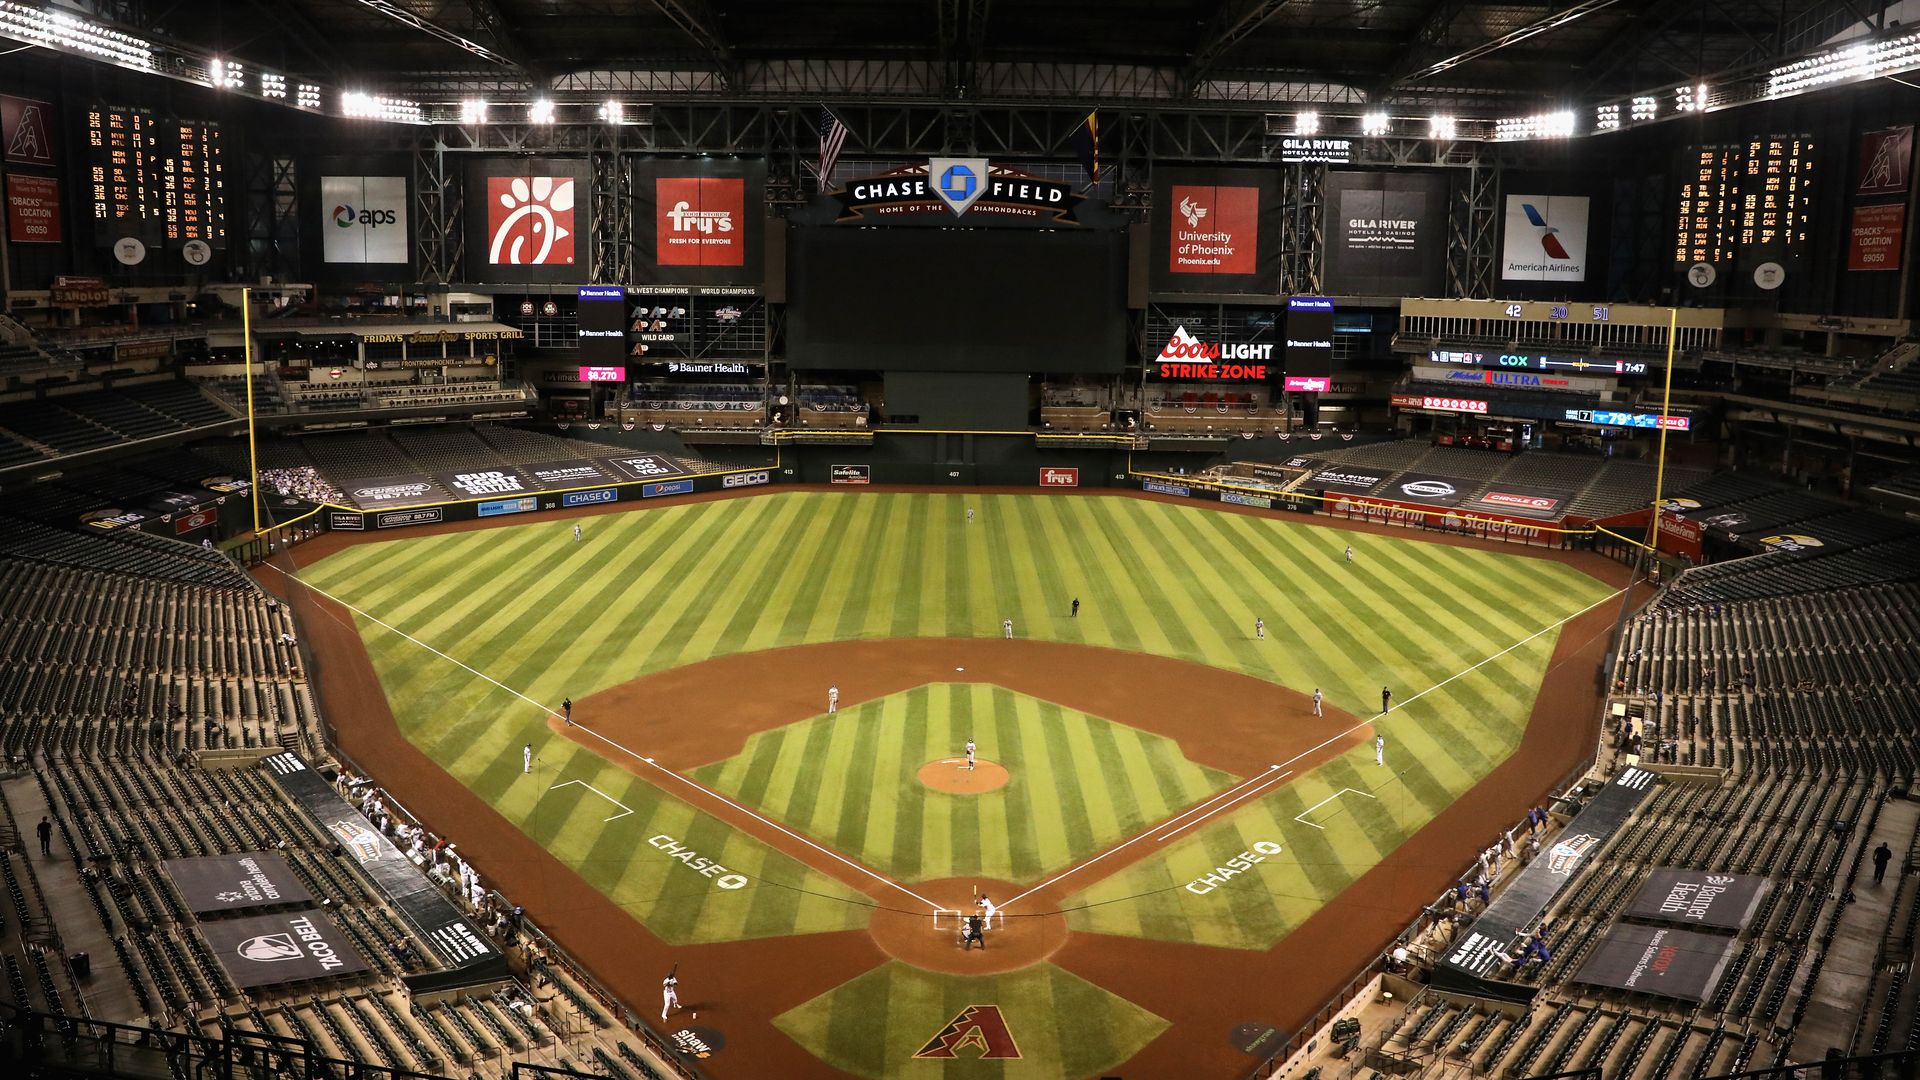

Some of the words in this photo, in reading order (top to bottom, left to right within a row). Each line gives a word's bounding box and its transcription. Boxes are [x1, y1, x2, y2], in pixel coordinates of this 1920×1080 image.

[1282, 140, 1312, 149] GILA
[1313, 140, 1349, 150] RIVER
[854, 181, 924, 200] CHASE
[993, 182, 1062, 202] FIELD
[19, 208, 52, 217] LOCATION
[667, 201, 732, 234] fry's
[974, 206, 1036, 216] DIAMONDBACKS
[359, 210, 396, 228] aps
[1350, 220, 1377, 228] GILA
[1379, 221, 1415, 229] RIVER
[1179, 231, 1231, 244] University
[1860, 236, 1892, 245] LOCATION
[1178, 245, 1190, 254] of
[1192, 245, 1233, 255] Phoenix
[1548, 264, 1580, 272] Airlines
[1506, 305, 1521, 317] 42
[1550, 306, 1568, 319] 20
[1593, 307, 1609, 320] 51
[364, 335, 403, 343] FRIDAYS
[465, 332, 498, 340] SPORTS
[500, 331, 524, 339] GRILL
[1161, 335, 1220, 359] Coors
[1221, 344, 1273, 359] LIGHT
[1499, 355, 1528, 366] COX
[680, 364, 713, 372] Banner
[714, 363, 744, 372] Health
[1160, 364, 1217, 378] STRIKE
[1220, 364, 1265, 379] ZONE
[1625, 363, 1645, 373] 7:47
[1493, 373, 1540, 385] ULTRA
[452, 476, 518, 488] LIGHT
[454, 472, 504, 481] BUD
[724, 474, 768, 487] GEICO
[1045, 470, 1072, 484] fry's
[1346, 474, 1378, 482] RIVER
[465, 482, 525, 495] SELTZER
[664, 484, 681, 492] pepsi
[1406, 485, 1451, 494] NISSAN
[569, 493, 602, 503] CHASE
[1490, 494, 1531, 503] CIRCLE
[1355, 500, 1424, 522] StateFarm
[1465, 514, 1539, 538] StateFarm
[1665, 521, 1695, 540] StateFarm
[648, 834, 728, 878] CHASE
[1186, 851, 1266, 894] CHASE
[1660, 882, 1701, 913] Health
[1685, 885, 1726, 920] Banner
[289, 916, 322, 942] BELL
[1650, 930, 1668, 946] Business
[308, 941, 344, 970] TACO
[1639, 946, 1658, 968] Solutions
[1650, 945, 1679, 972] xerox
[1624, 963, 1648, 987] Southwest
[678, 1030, 712, 1052] shaw
